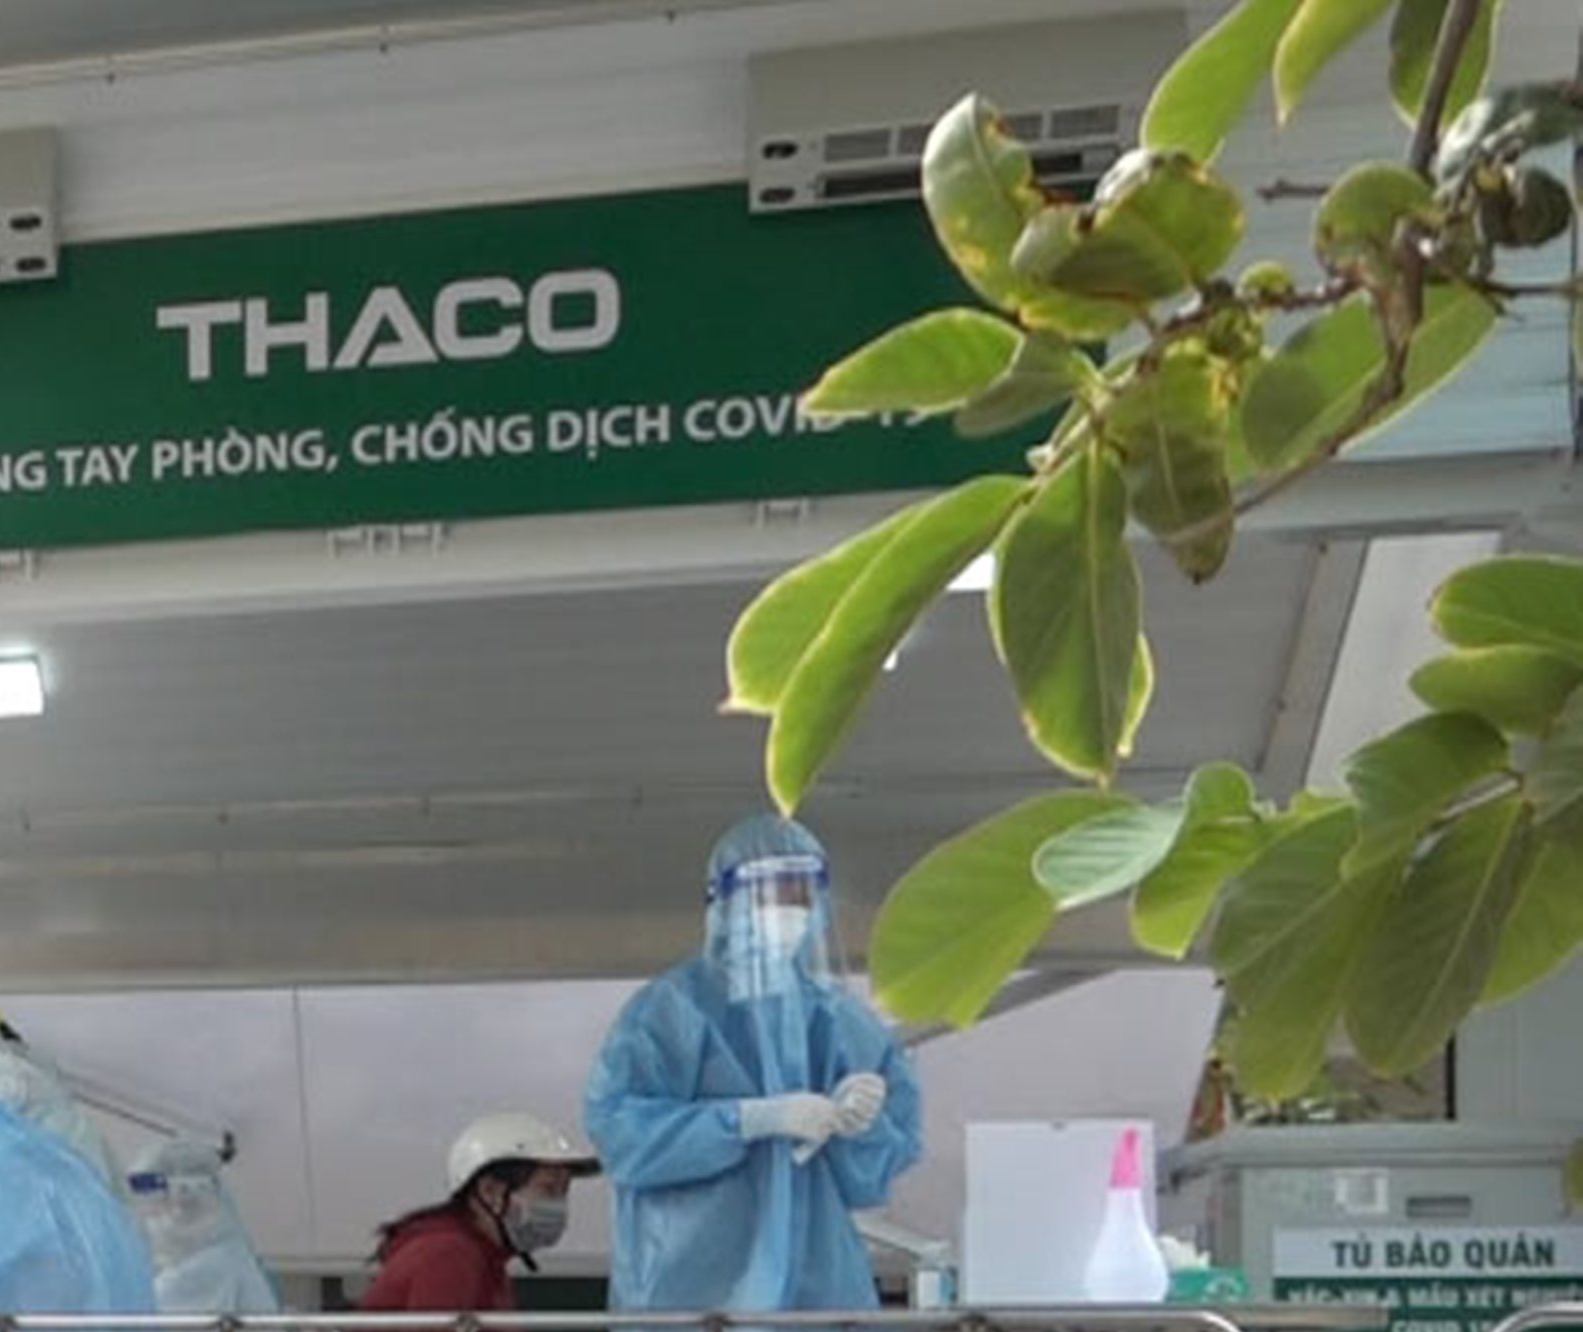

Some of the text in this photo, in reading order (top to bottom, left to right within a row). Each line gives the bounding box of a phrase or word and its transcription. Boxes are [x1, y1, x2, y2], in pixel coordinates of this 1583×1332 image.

[156, 267, 622, 382] THACO
[56, 444, 140, 487] TAY
[151, 426, 339, 481] PHÒNG,
[350, 406, 534, 465] CHỐNG
[547, 403, 671, 460] DỊCH
[1331, 1231, 1555, 1270] TỦ BẢO QUẢN
